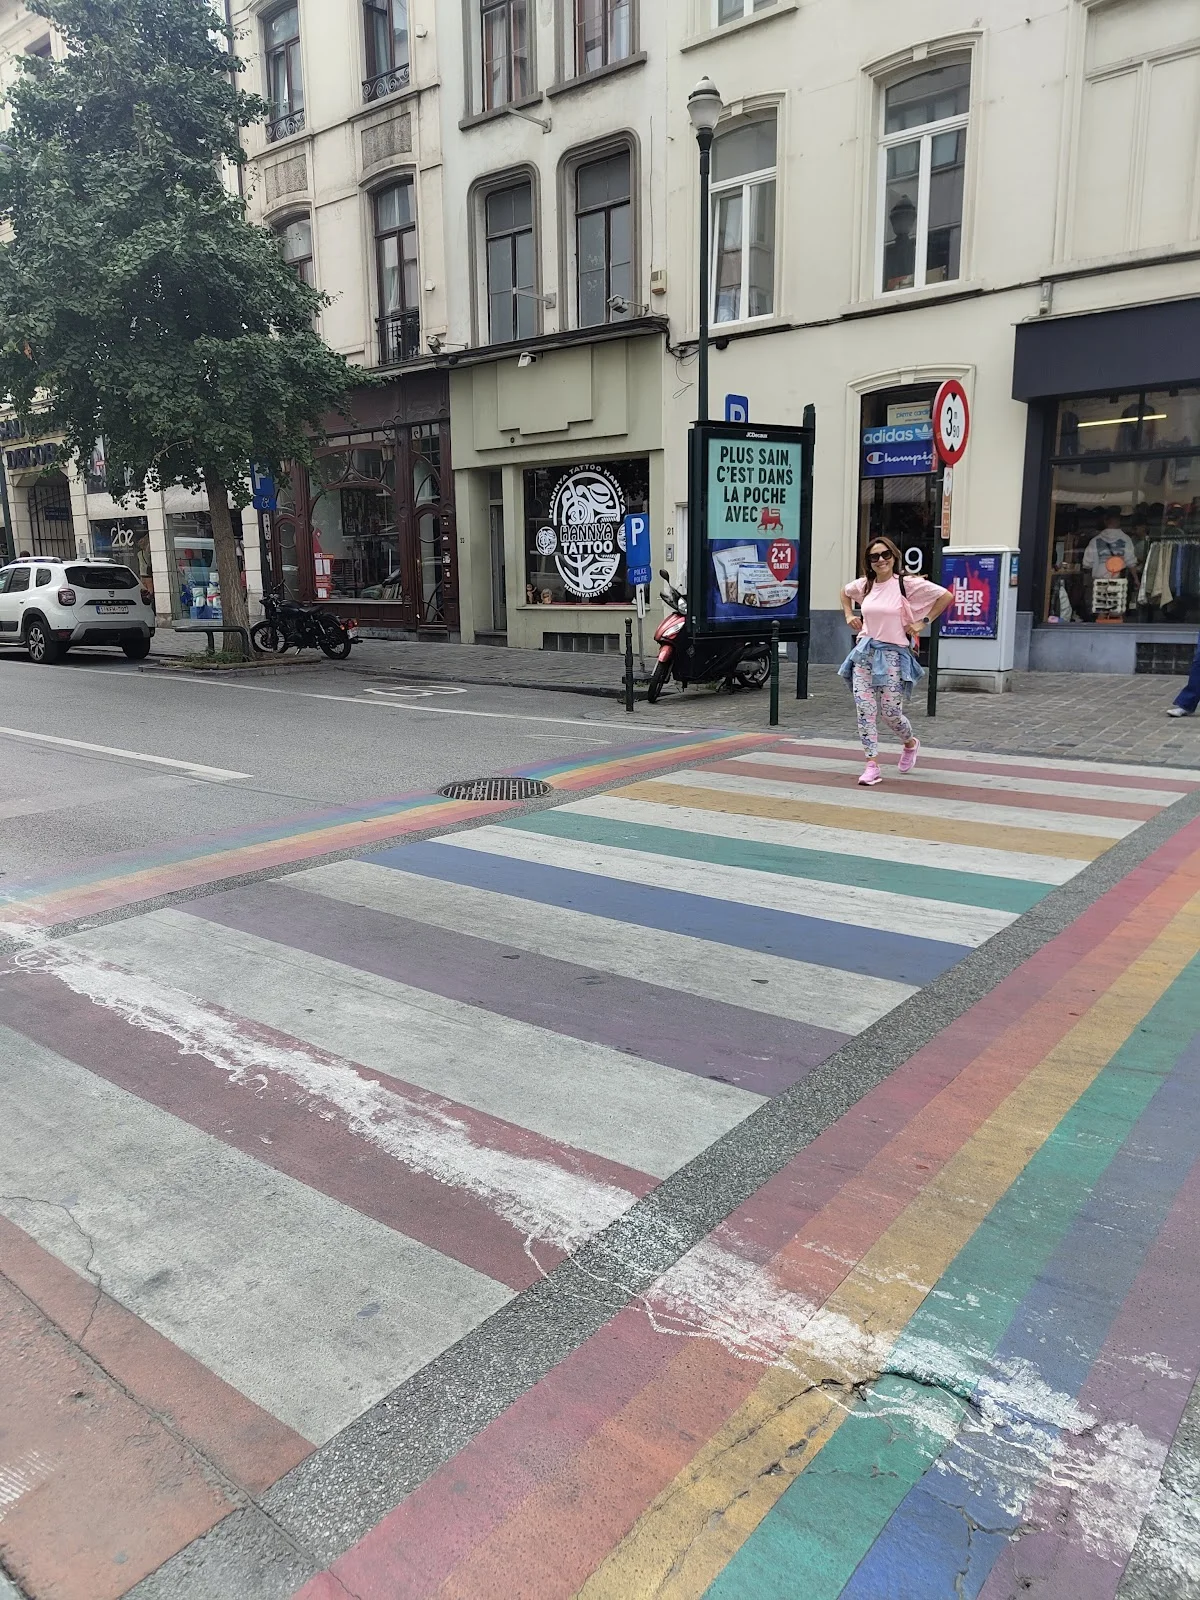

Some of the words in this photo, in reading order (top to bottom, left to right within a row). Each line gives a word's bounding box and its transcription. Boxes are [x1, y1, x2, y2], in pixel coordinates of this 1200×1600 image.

[946, 406, 953, 437] 3
[863, 428, 914, 444] adidas
[720, 446, 754, 464] PLUS
[758, 448, 792, 468] SAIN,
[716, 465, 755, 484] C'EST
[758, 468, 793, 486] DANS
[548, 474, 569, 519] HANNYA
[568, 464, 602, 475] TATTOO
[603, 469, 626, 515] HANNYA
[723, 485, 739, 503] LA
[743, 486, 786, 504] POCHE
[724, 506, 758, 523] AVEC
[559, 523, 614, 542] HANNYA
[631, 517, 645, 546] P
[666, 526, 674, 536] 21
[560, 541, 614, 555] TATTOO
[770, 547, 792, 563] 2+1
[633, 567, 648, 576] POLICE
[773, 562, 790, 570] GRATIS
[633, 575, 649, 583] POLITIE
[564, 582, 613, 598] HANNYATATTOO
[955, 590, 984, 603] BER
